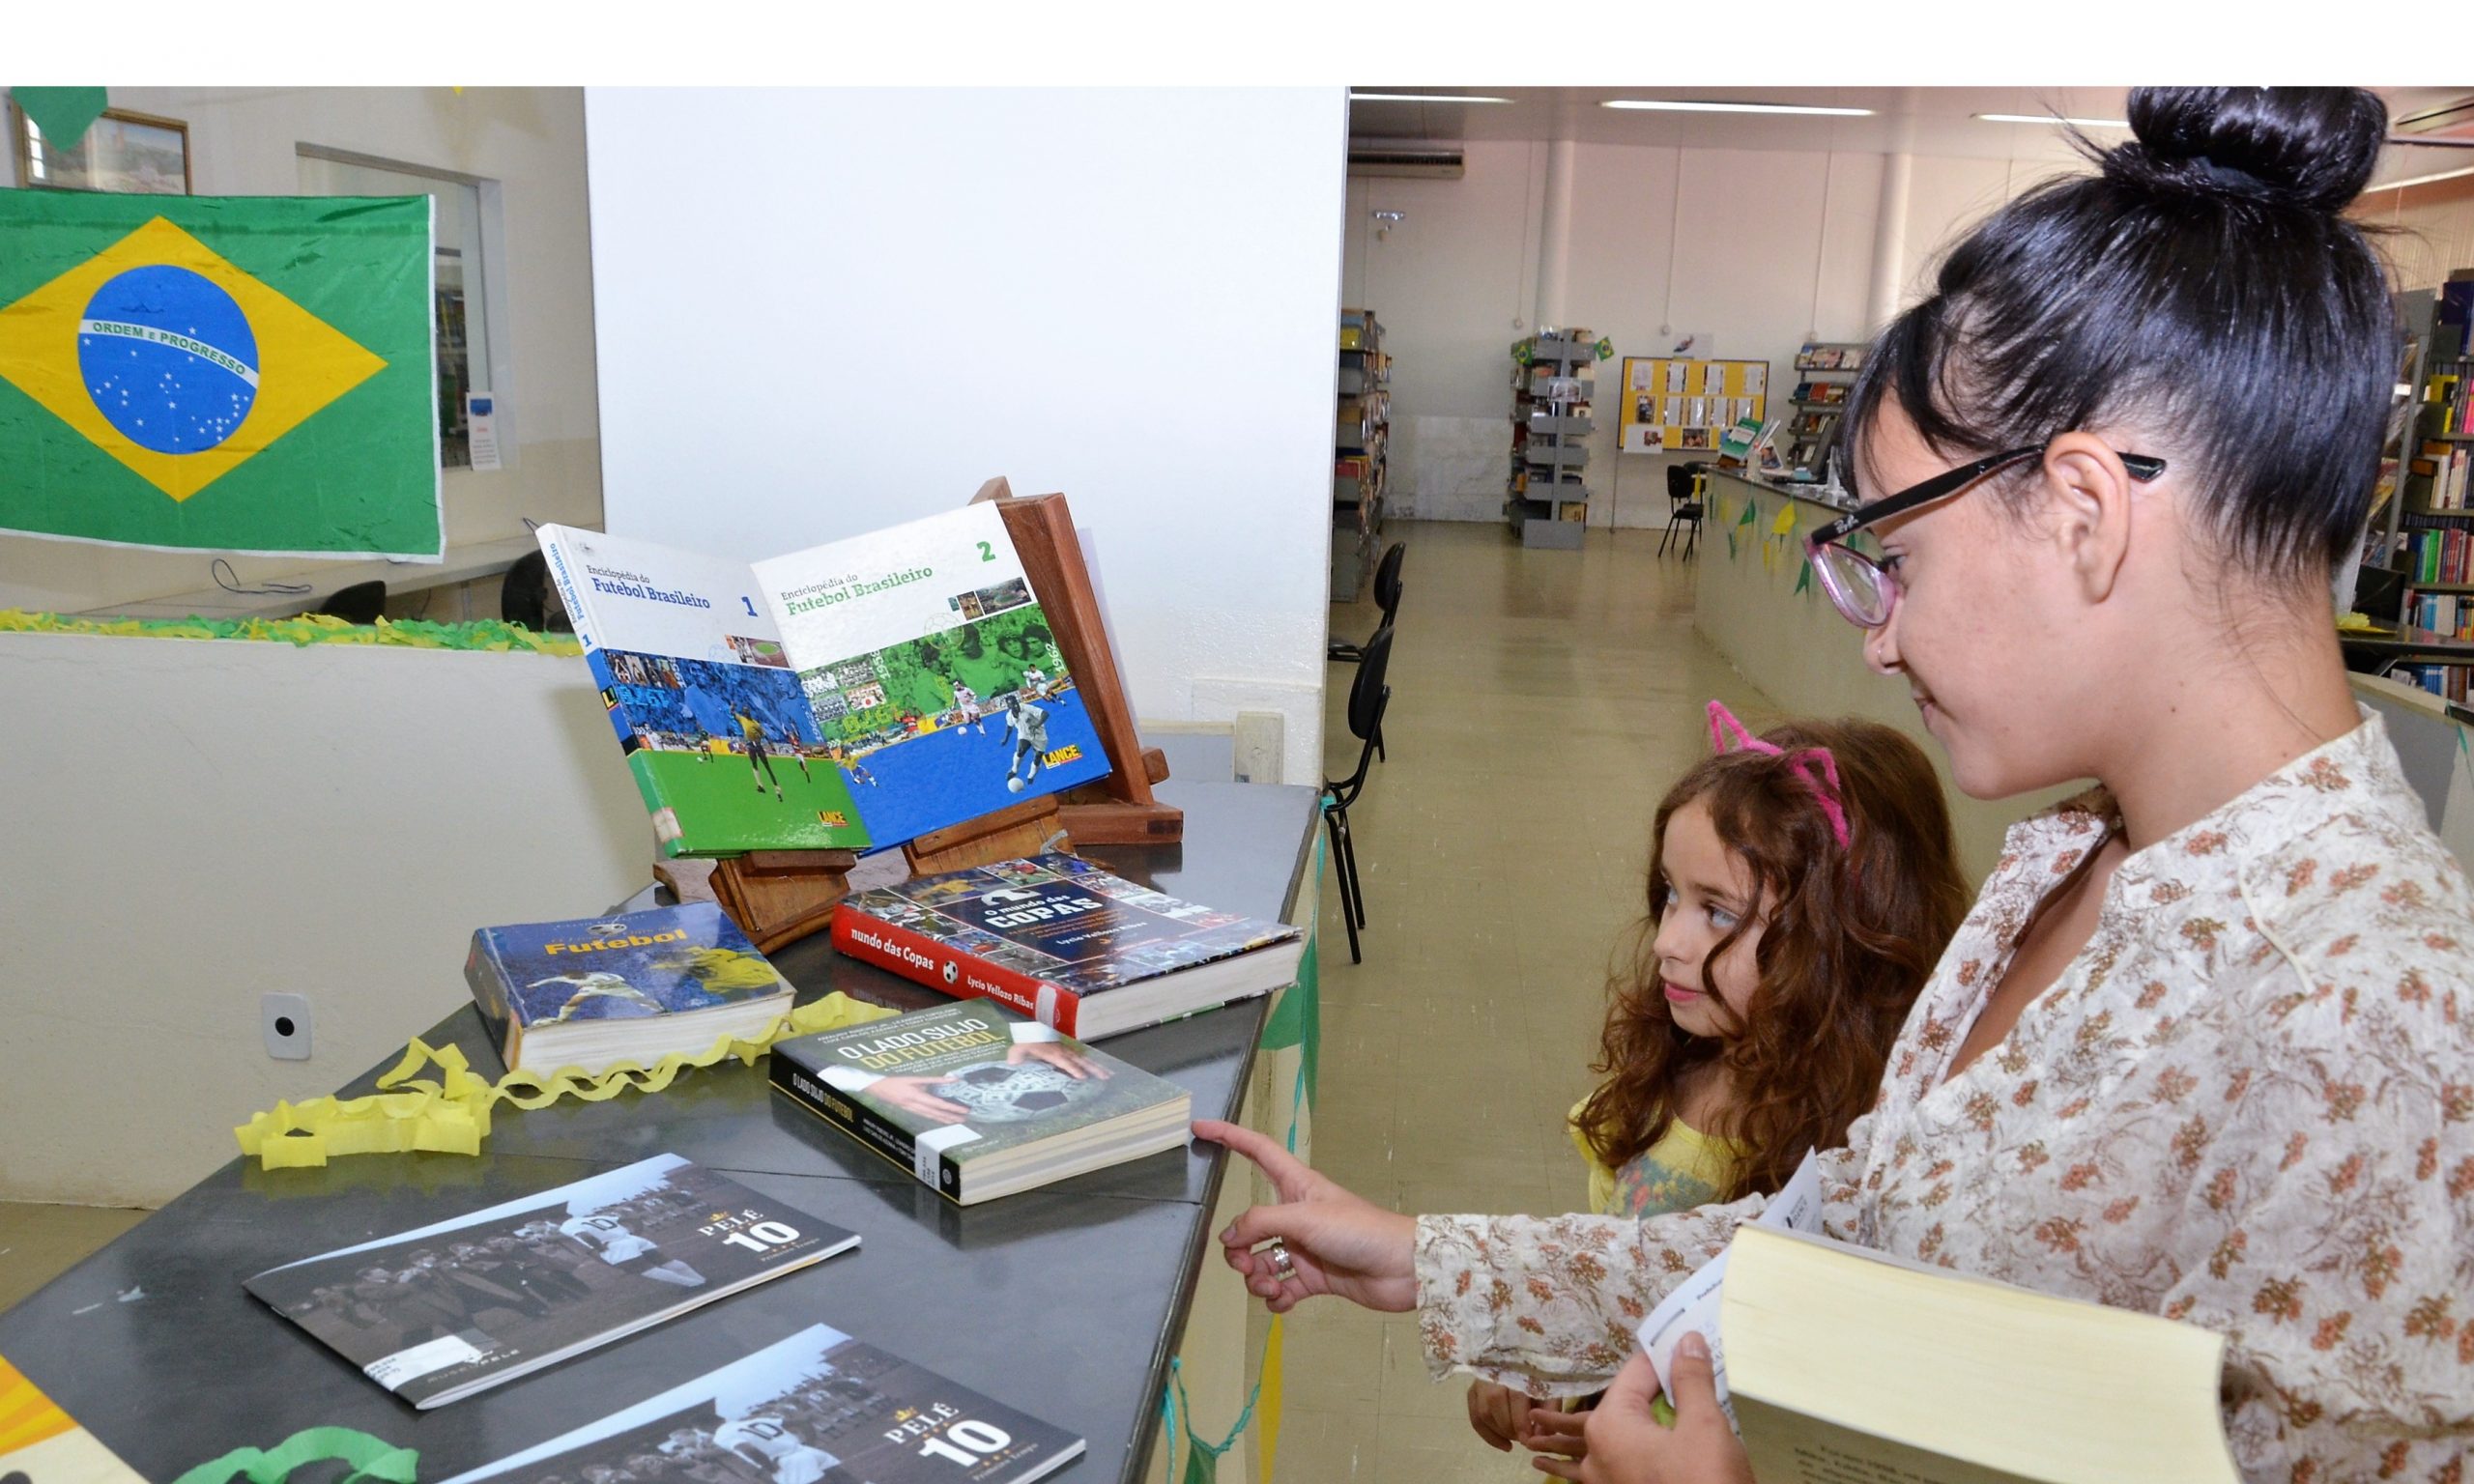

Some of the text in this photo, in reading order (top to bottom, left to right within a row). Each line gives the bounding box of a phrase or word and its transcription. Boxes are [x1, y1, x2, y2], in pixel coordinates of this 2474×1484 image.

[93, 322, 143, 337] ORDEM
[160, 333, 245, 375] PROGRESSO
[550, 543, 572, 586] Brasileiro
[976, 541, 995, 562] 2
[591, 577, 710, 609] Futebol Brasileiro
[639, 574, 650, 584] do
[781, 573, 858, 601] Enciclopédia do
[786, 566, 933, 615] Futebol Brasileiro
[741, 596, 758, 617] 1
[582, 634, 592, 647] 1
[1046, 642, 1065, 672] 1962
[985, 899, 1104, 928] COPAS
[998, 899, 1046, 914] mundo
[544, 928, 687, 955] Futebol
[883, 938, 902, 957] das
[903, 947, 935, 971] Copas
[967, 975, 1034, 1010] Lycio Vellozo Ribas
[837, 1046, 863, 1059] O
[857, 1032, 927, 1054] LADO
[921, 1018, 989, 1042] SUJO
[858, 1051, 903, 1070] DO
[898, 1032, 1006, 1061] FUTEBOL
[722, 1221, 800, 1252] 10
[918, 1419, 1012, 1467] 10
